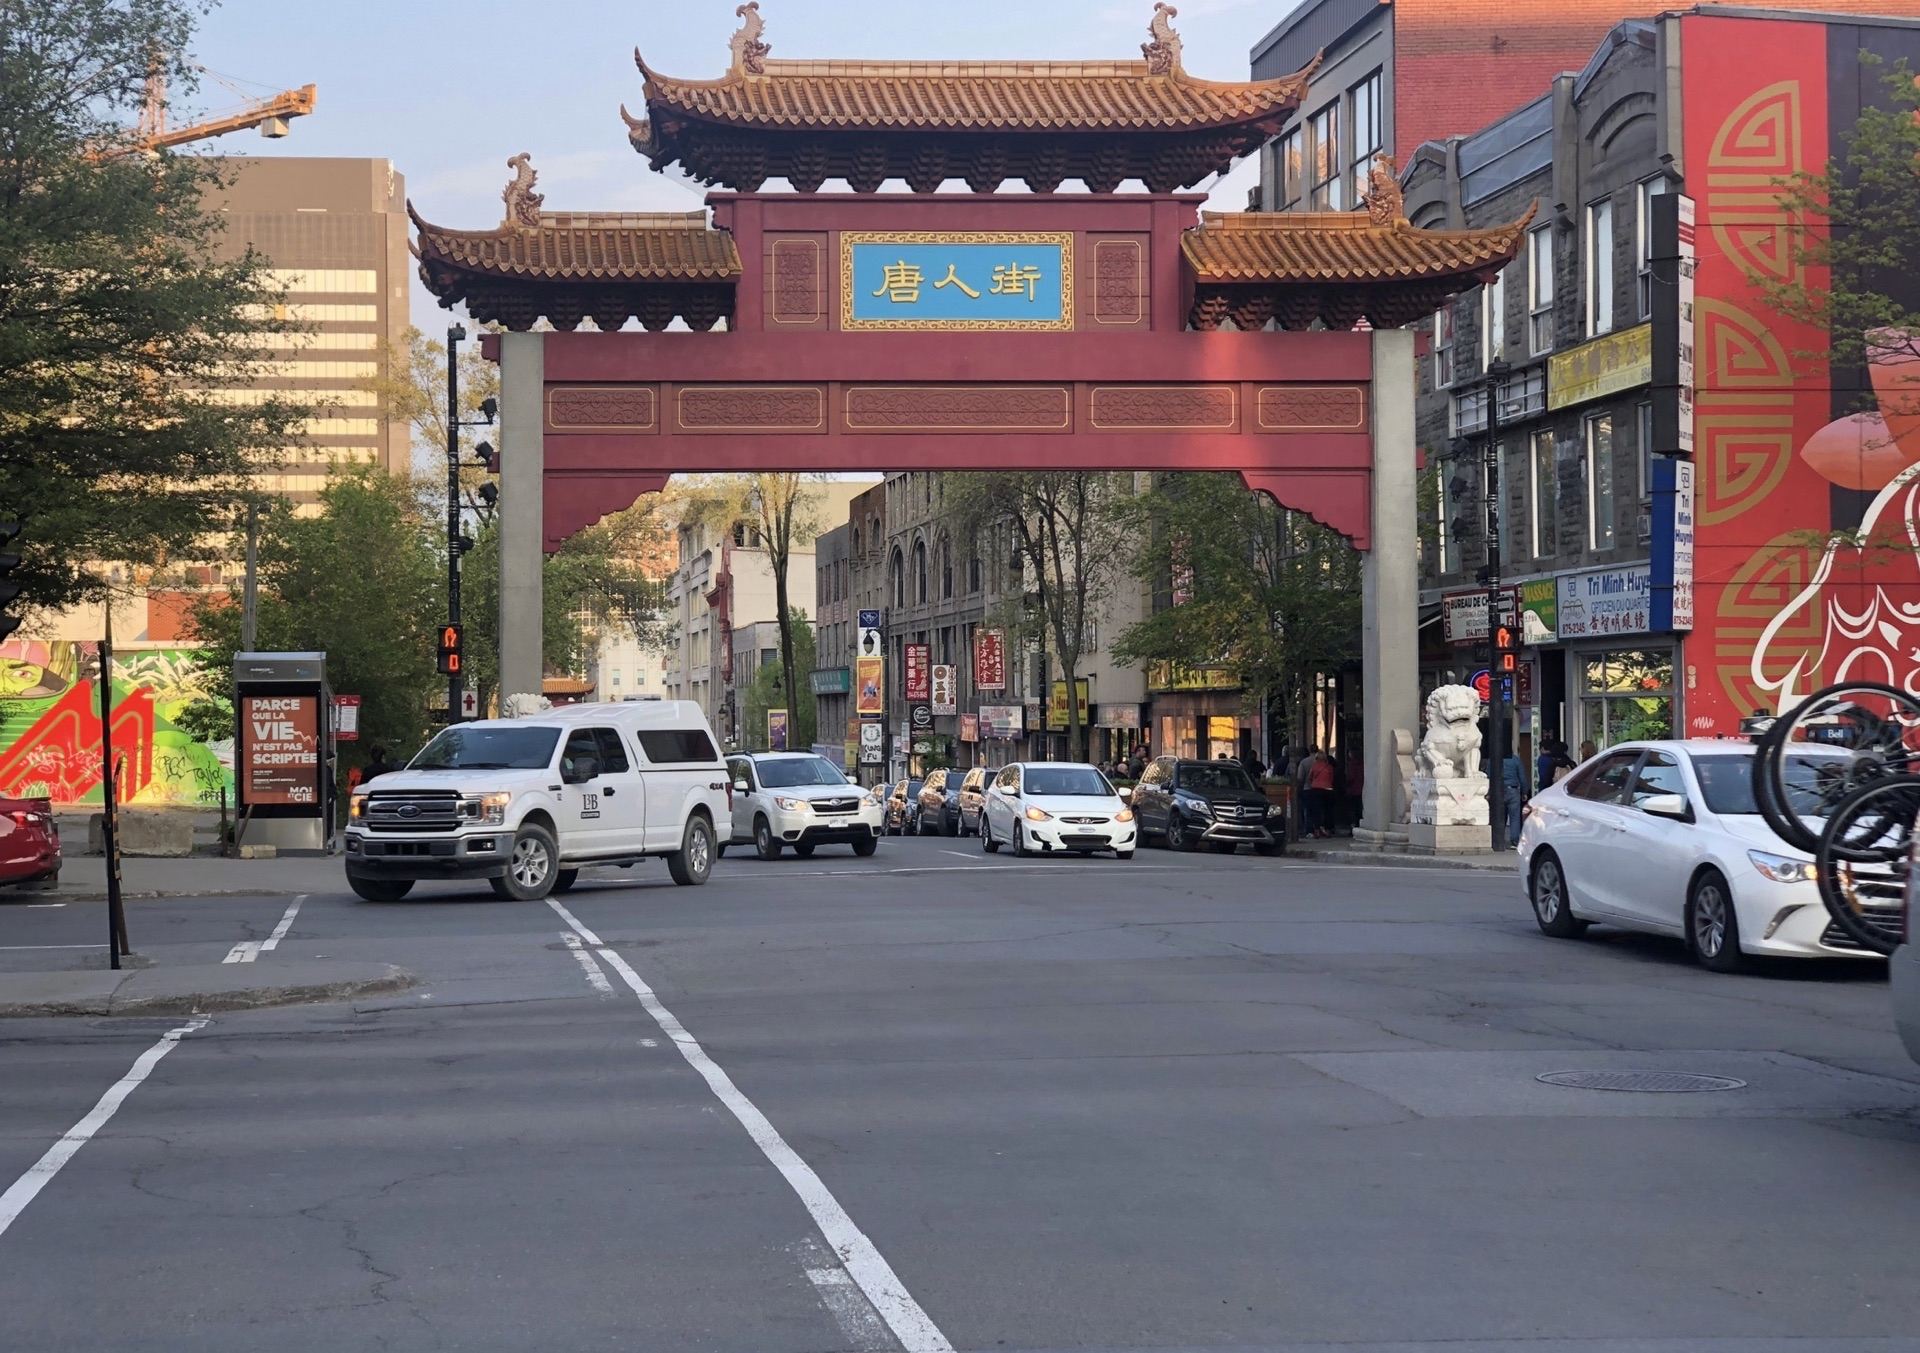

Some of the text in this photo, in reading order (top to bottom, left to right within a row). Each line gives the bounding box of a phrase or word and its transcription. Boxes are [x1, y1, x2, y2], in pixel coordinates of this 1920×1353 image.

[872, 260, 1042, 304] 唐人街
[1682, 494, 1690, 508] Tri
[1677, 511, 1692, 525] Minh
[1674, 532, 1693, 546] Huynh
[1587, 577, 1599, 596] Tri
[1602, 573, 1624, 595] Minh
[1524, 582, 1554, 602] MASSAGE
[1450, 597, 1473, 609] BUREAU
[1473, 596, 1481, 608] DE
[1562, 622, 1585, 635] 875-2345
[993, 635, 1002, 682] MASSAGE
[252, 699, 300, 711] PARCE
[252, 712, 286, 720] QUE LA
[252, 721, 295, 740] VIE
[1827, 728, 1844, 739] Bell
[252, 743, 303, 751] N'EST PAS
[252, 750, 318, 764] SCRIPTÉE
[294, 793, 313, 802] CIE
